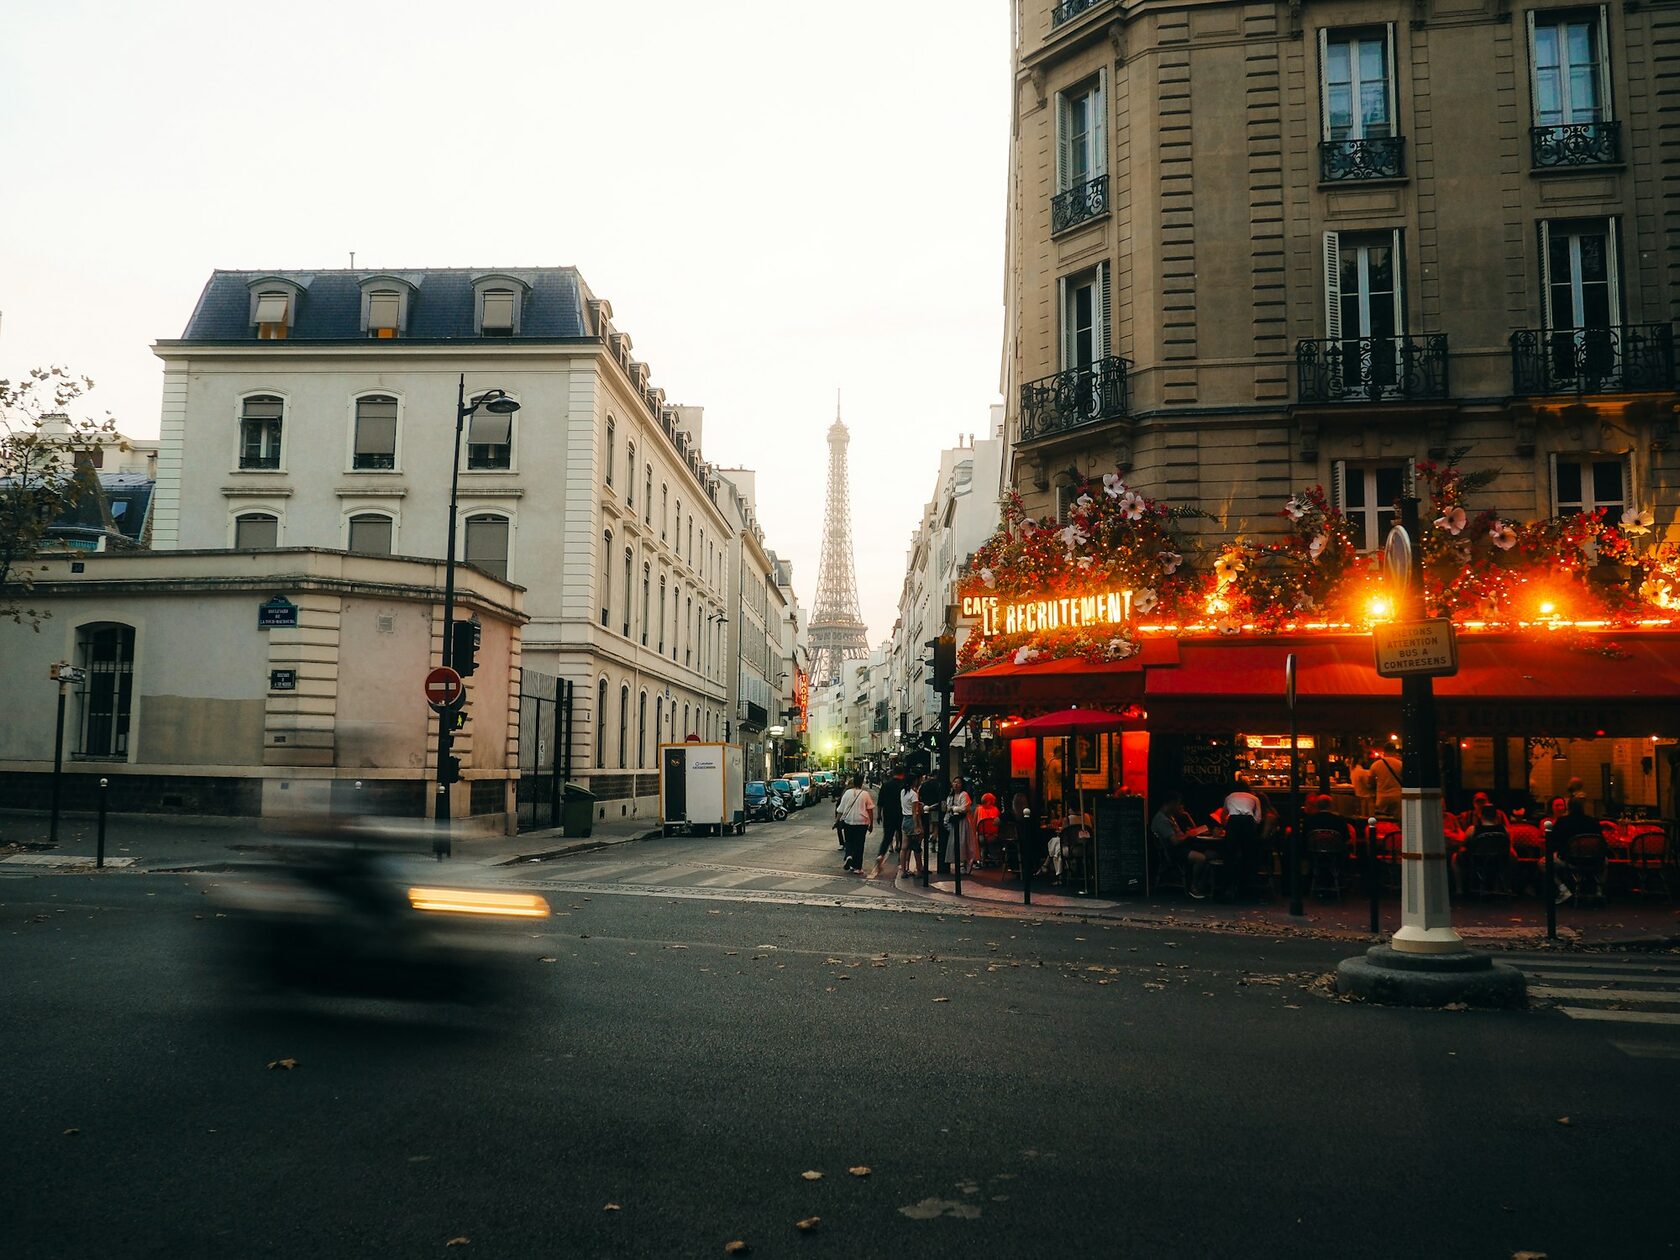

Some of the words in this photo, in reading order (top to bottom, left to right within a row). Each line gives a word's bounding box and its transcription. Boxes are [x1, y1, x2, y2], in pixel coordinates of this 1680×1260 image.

[983, 607, 1000, 636] LE
[1006, 590, 1133, 634] RECRUTEMENT
[1387, 637, 1438, 649] ATTENTION
[1400, 648, 1418, 658] BUS
[1422, 648, 1429, 656] A
[1384, 656, 1447, 670] CONTRESENS
